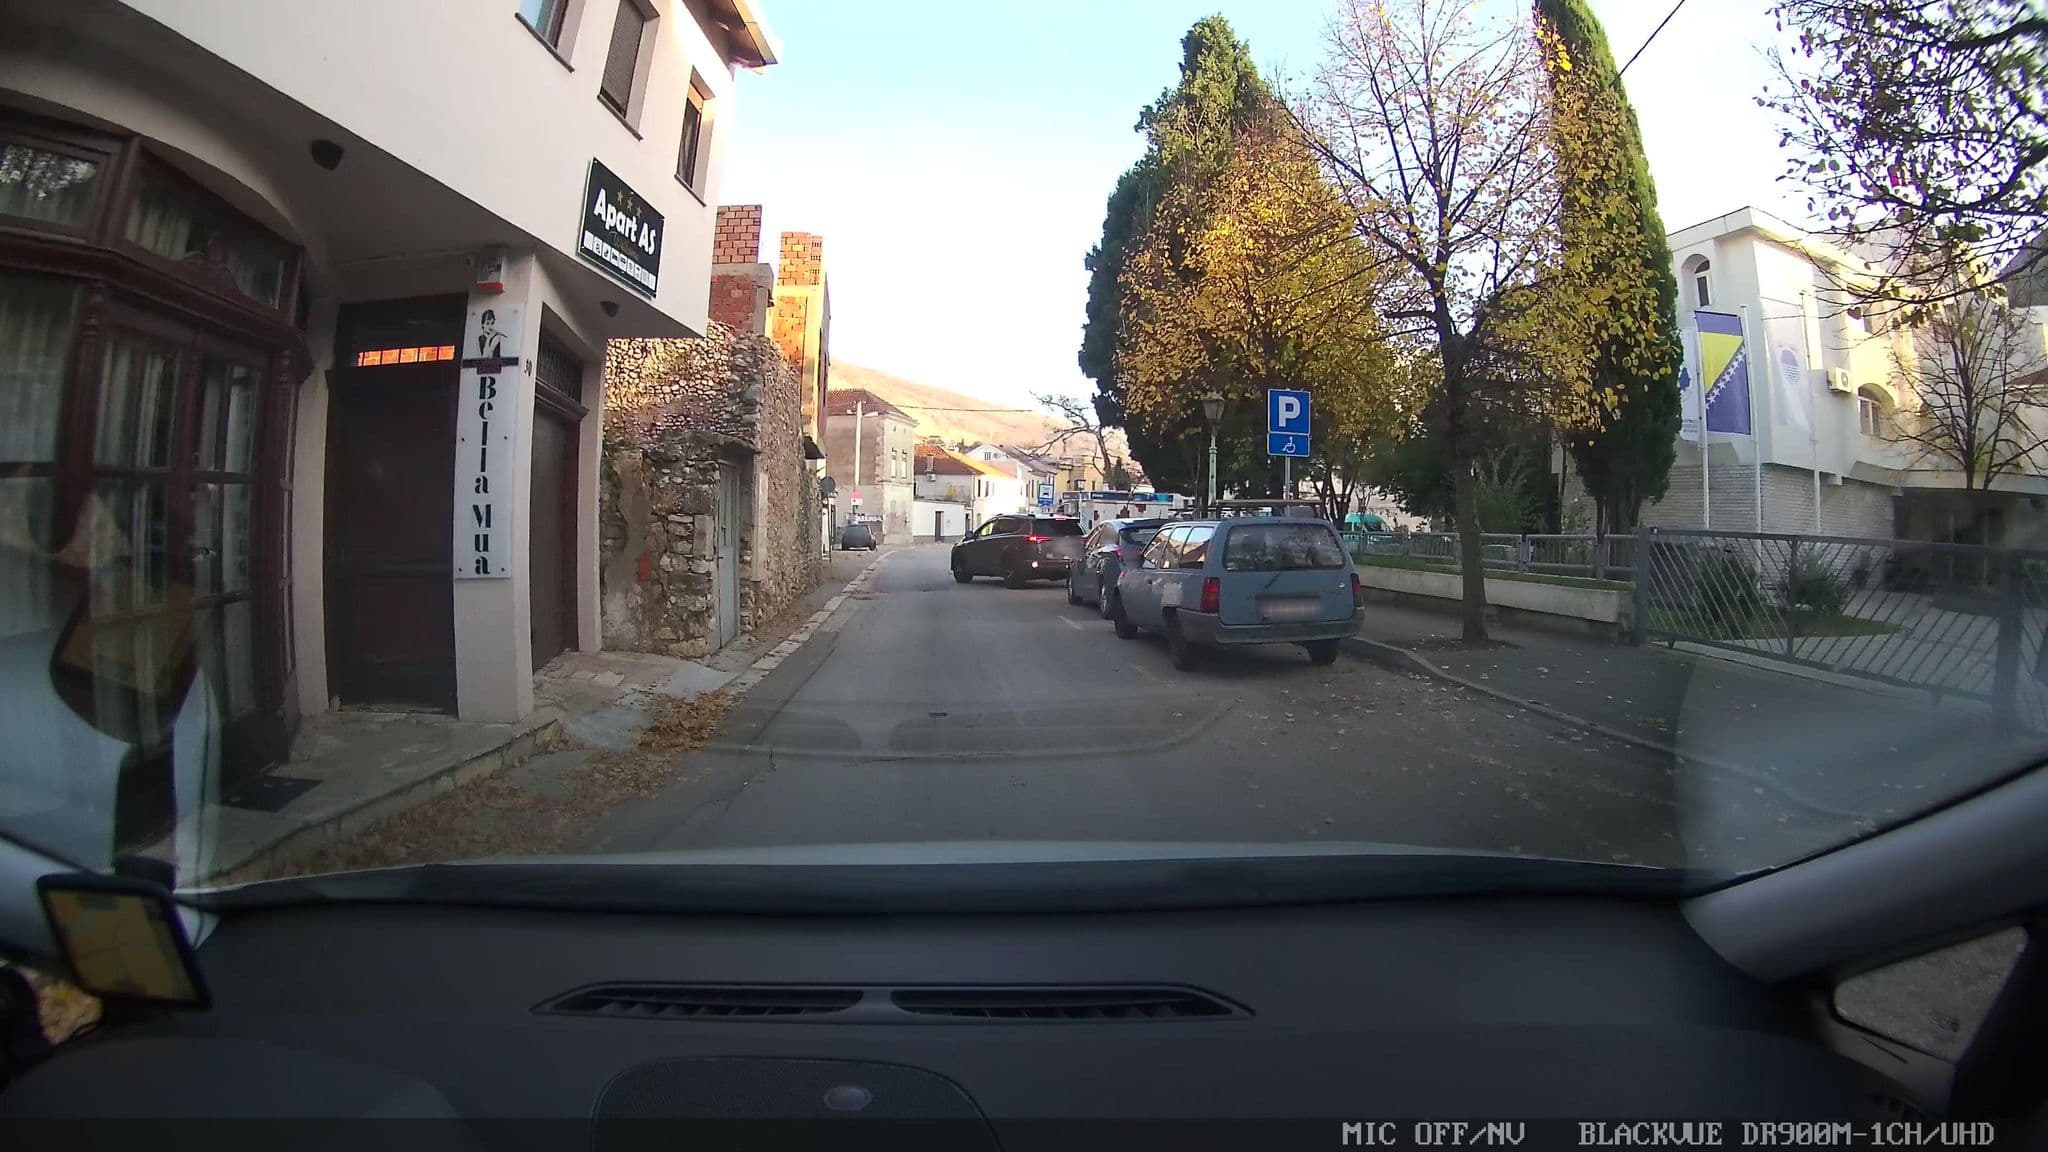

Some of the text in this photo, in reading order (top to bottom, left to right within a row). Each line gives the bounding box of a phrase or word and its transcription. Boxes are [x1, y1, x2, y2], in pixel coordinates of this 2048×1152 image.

[593, 188, 637, 243] Apart
[638, 222, 656, 255] AS
[1278, 395, 1300, 427] P
[472, 376, 497, 575] Bella Mua
